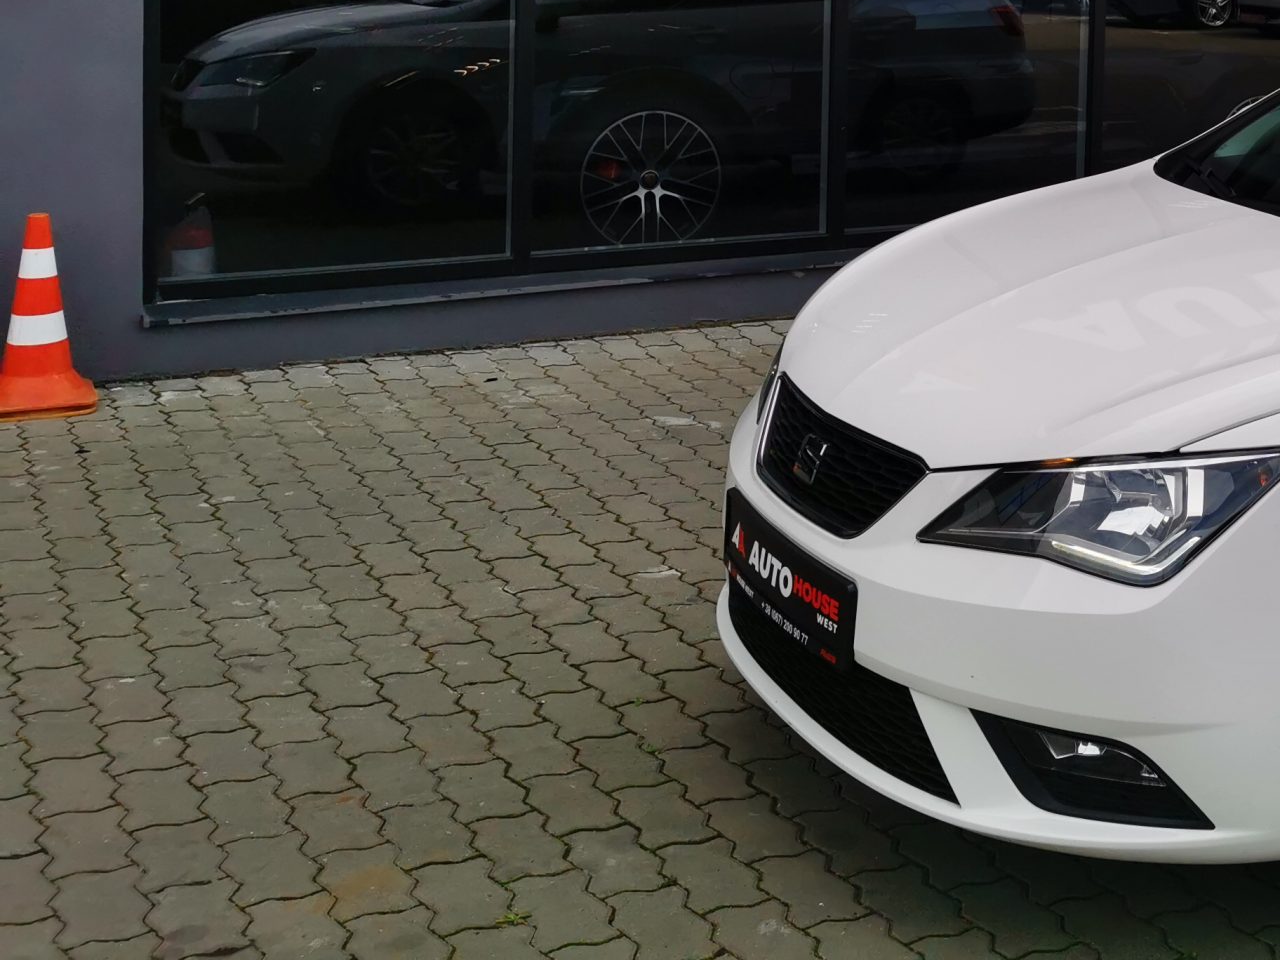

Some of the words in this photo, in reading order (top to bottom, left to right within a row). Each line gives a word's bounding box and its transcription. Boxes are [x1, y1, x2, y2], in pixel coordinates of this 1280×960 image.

[748, 540, 793, 598] AUTO
[793, 574, 840, 622] HOUSE
[816, 612, 838, 634] WEST
